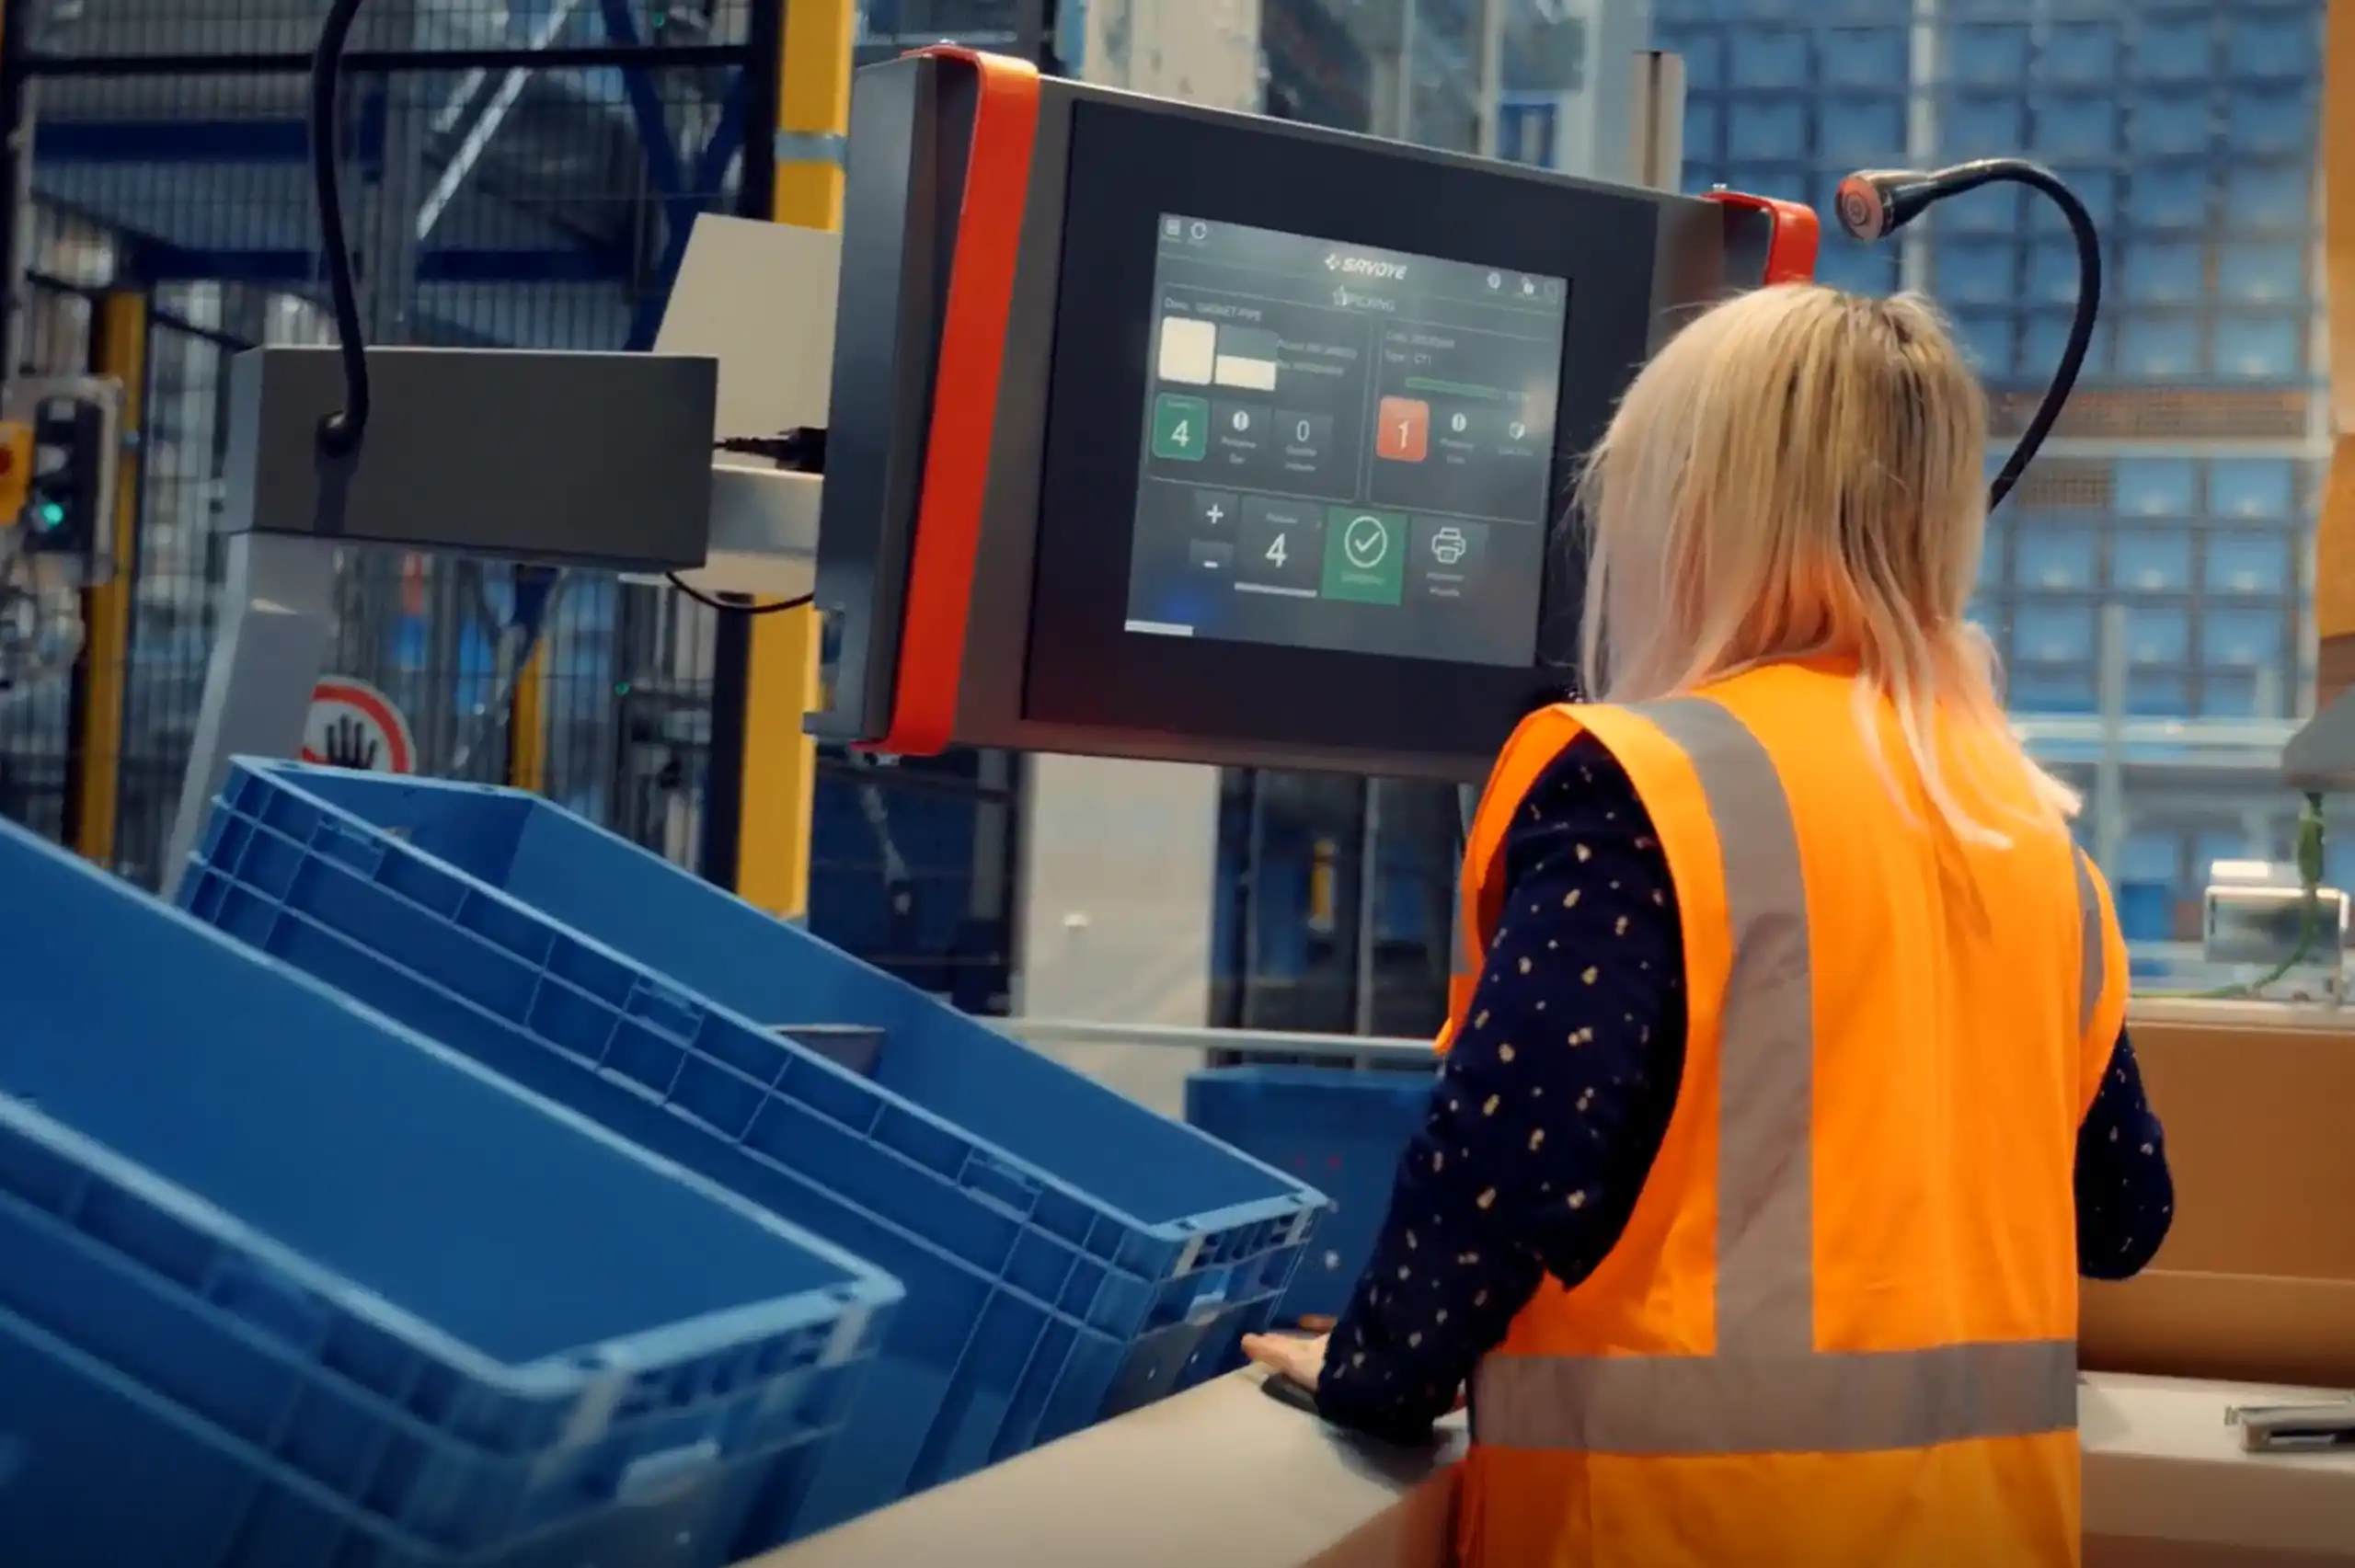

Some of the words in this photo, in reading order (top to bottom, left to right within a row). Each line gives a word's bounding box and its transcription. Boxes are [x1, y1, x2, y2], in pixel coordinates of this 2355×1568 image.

[1342, 258, 1407, 280] SAVOYE
[1170, 419, 1191, 448] 4
[1296, 419, 1310, 442] 0
[1398, 419, 1410, 451] 1
[1265, 532, 1288, 568] 4
